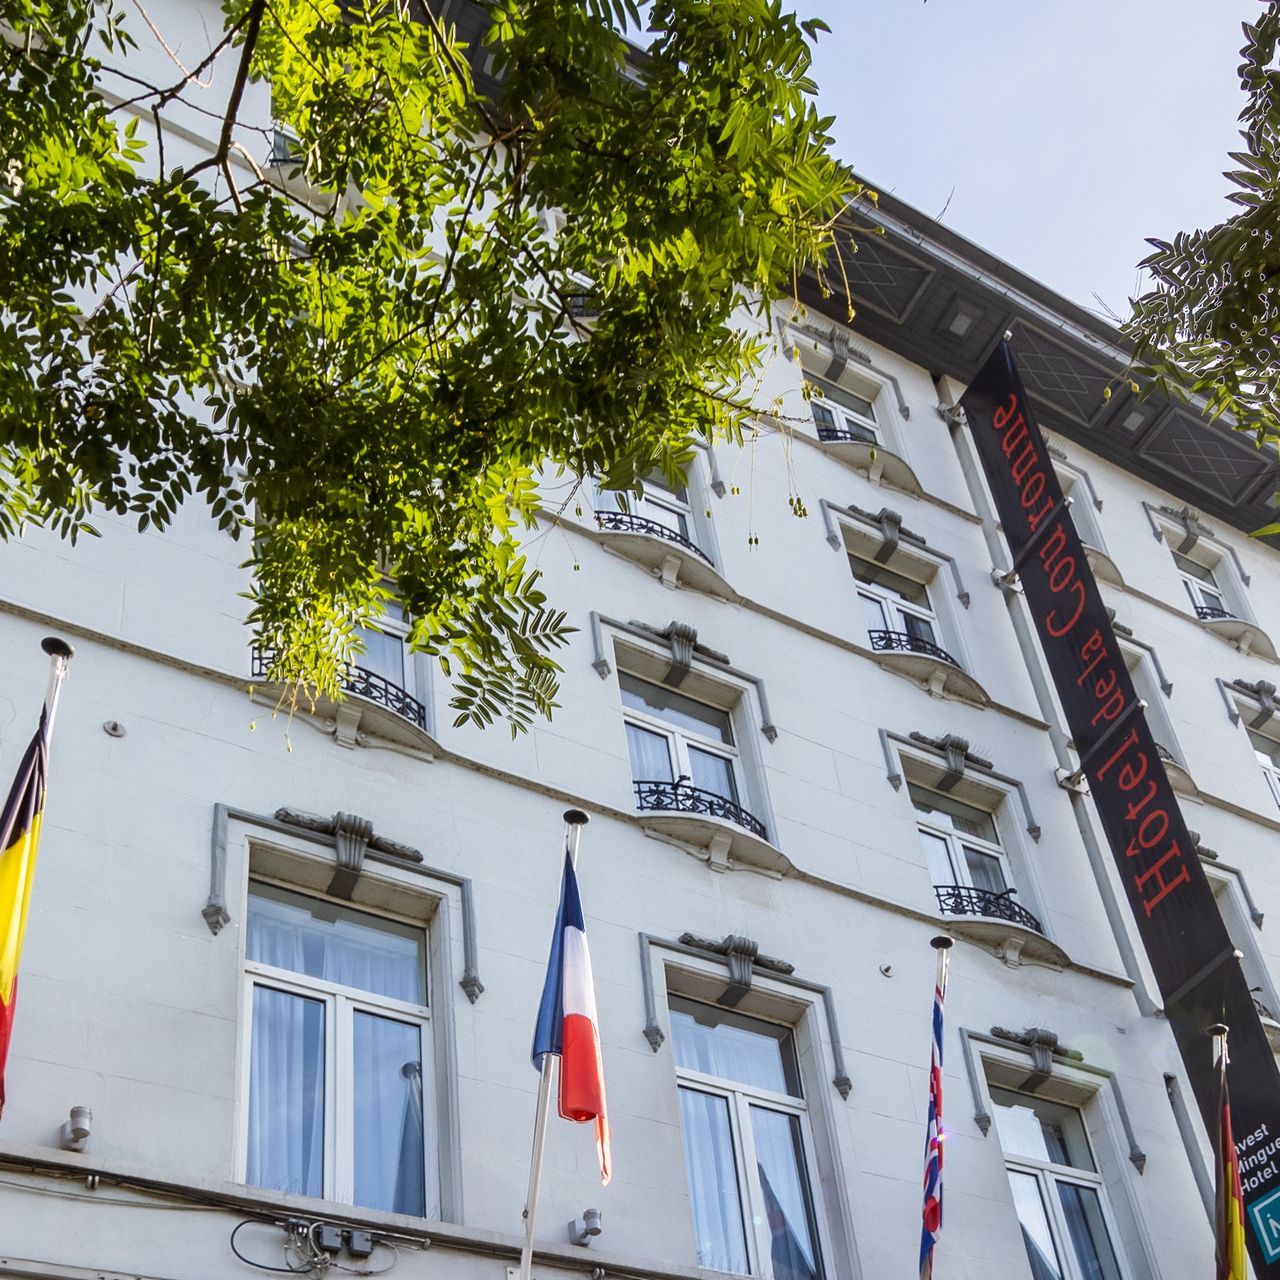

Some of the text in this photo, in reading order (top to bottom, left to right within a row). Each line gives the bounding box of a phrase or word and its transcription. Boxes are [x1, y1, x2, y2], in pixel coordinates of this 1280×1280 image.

[992, 393, 1191, 918] Hôtel de la Couronne
[1240, 1161, 1279, 1196] Hotel
